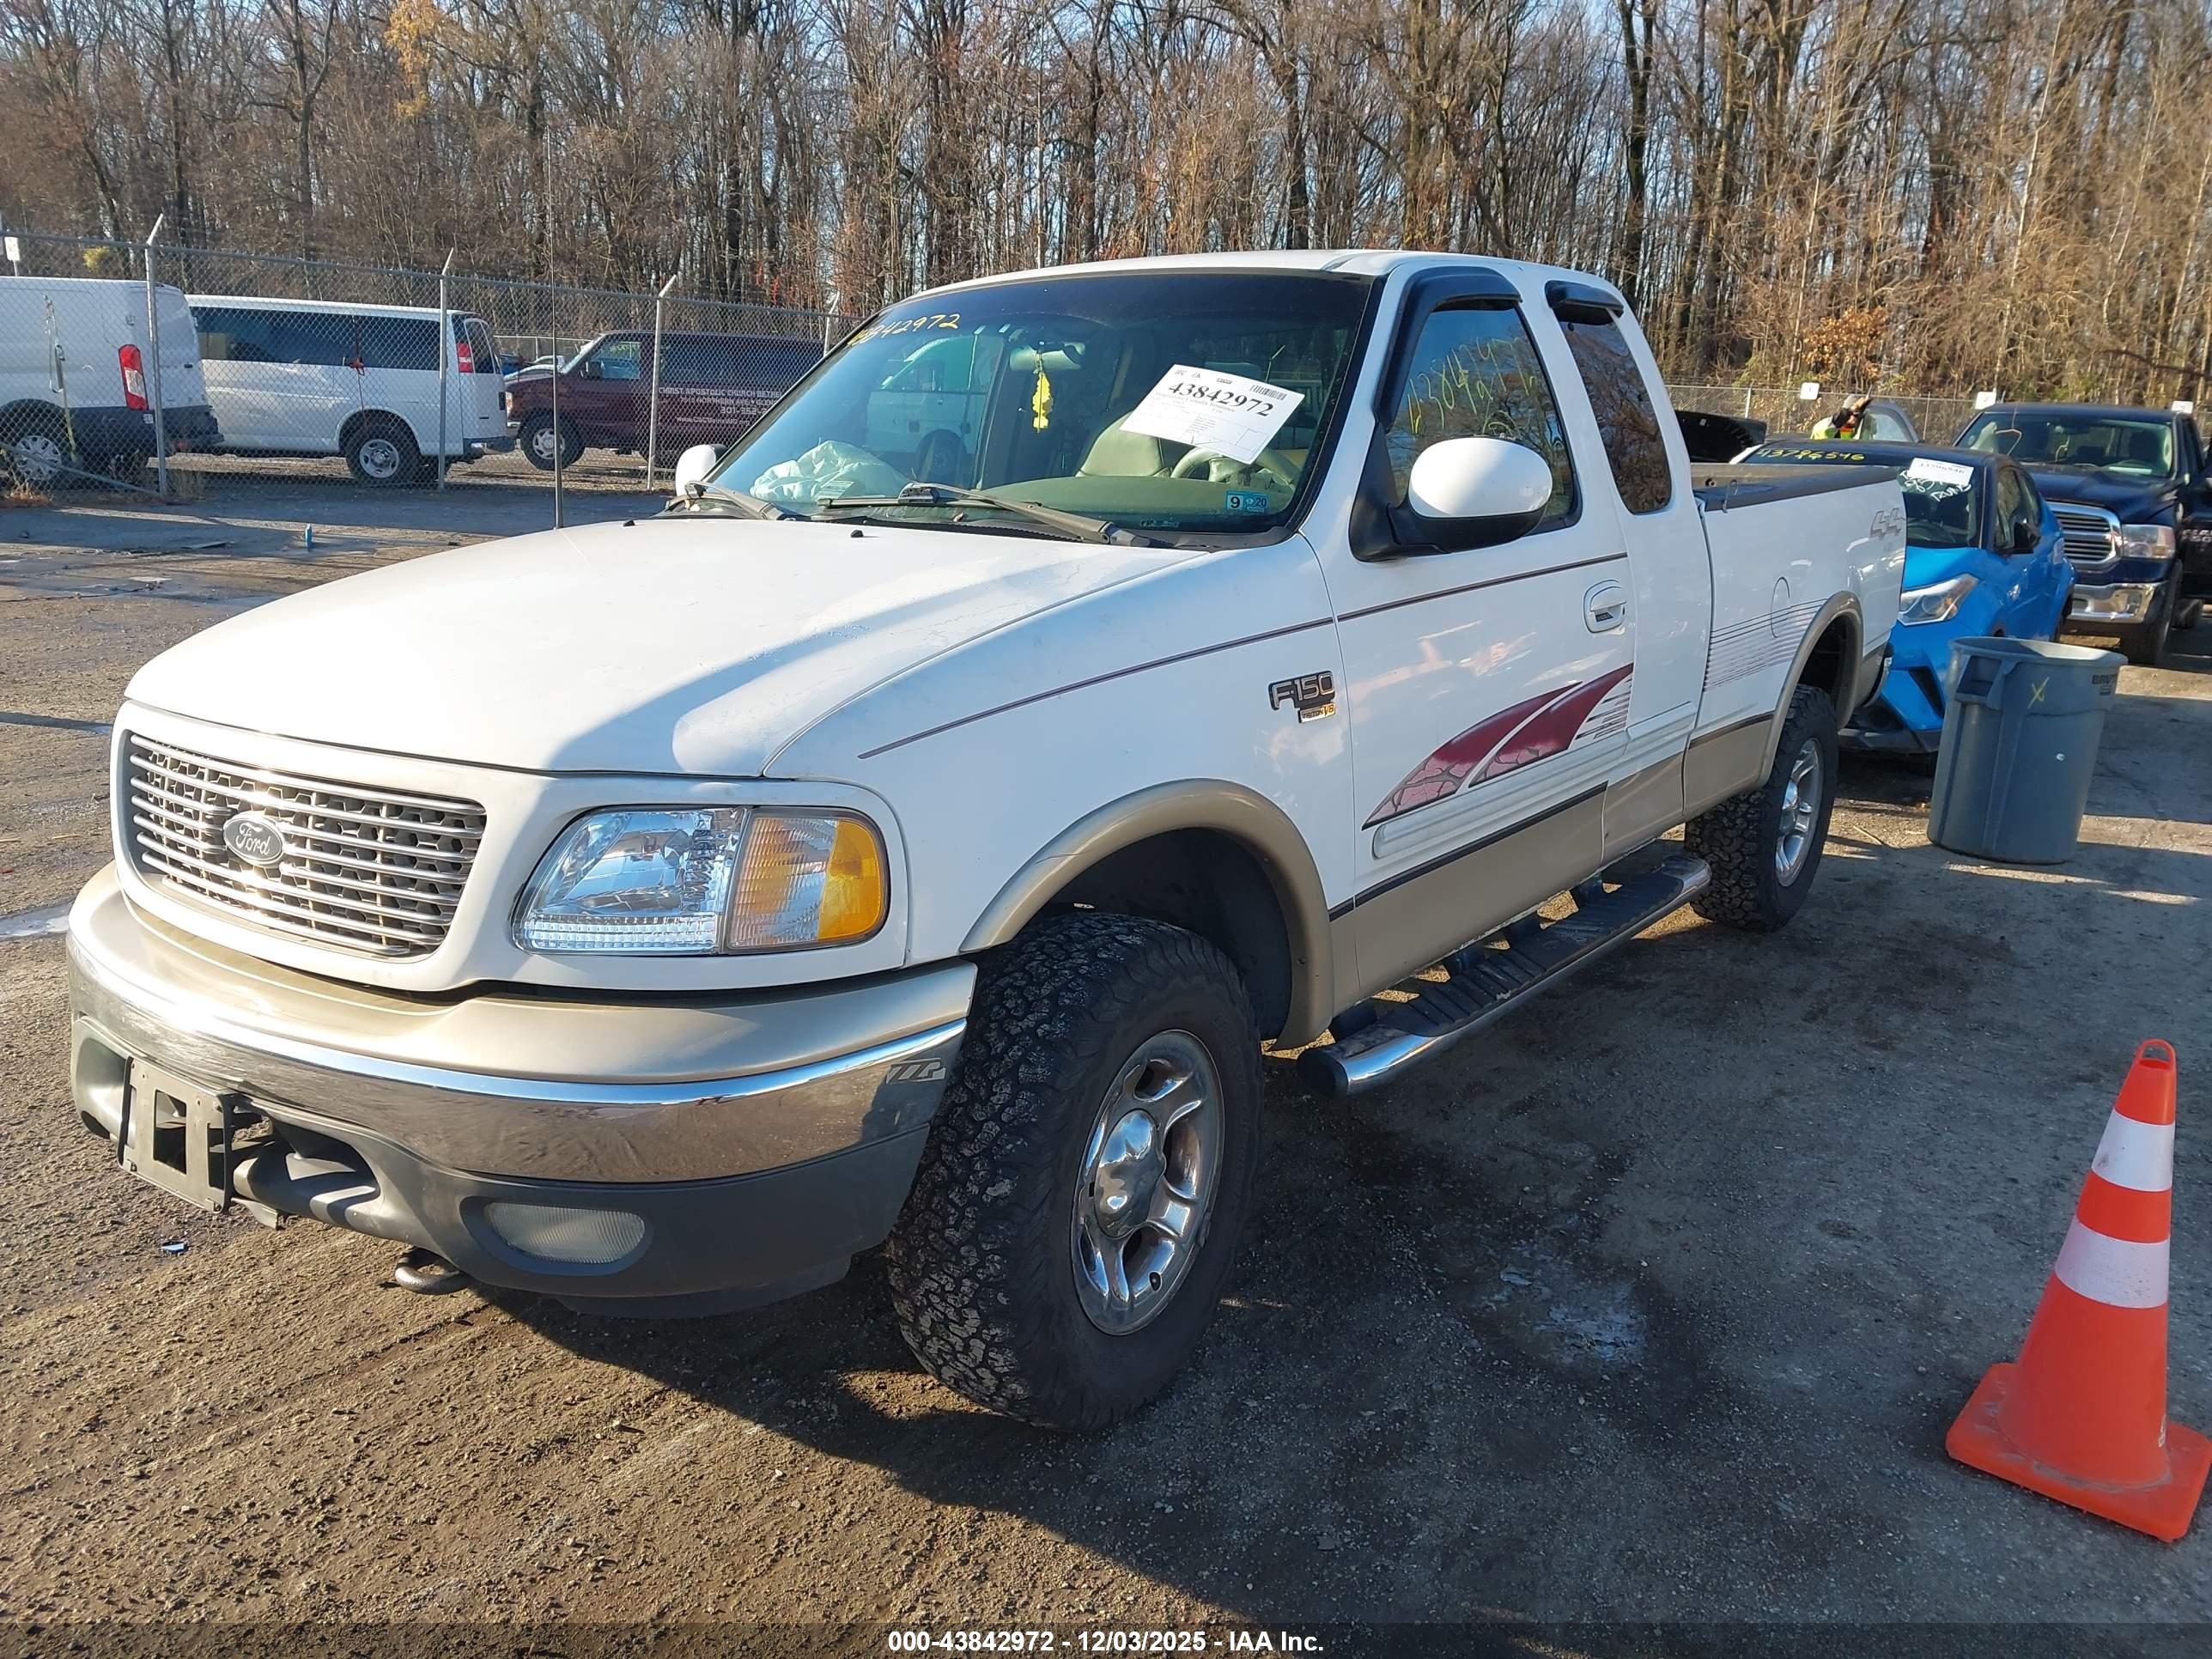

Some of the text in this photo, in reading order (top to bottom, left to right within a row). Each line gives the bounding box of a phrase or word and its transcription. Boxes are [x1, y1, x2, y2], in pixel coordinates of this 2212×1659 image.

[1168, 381, 1274, 417] 43842972
[1230, 495, 1267, 508] 9 20
[235, 822, 272, 856] Ford
